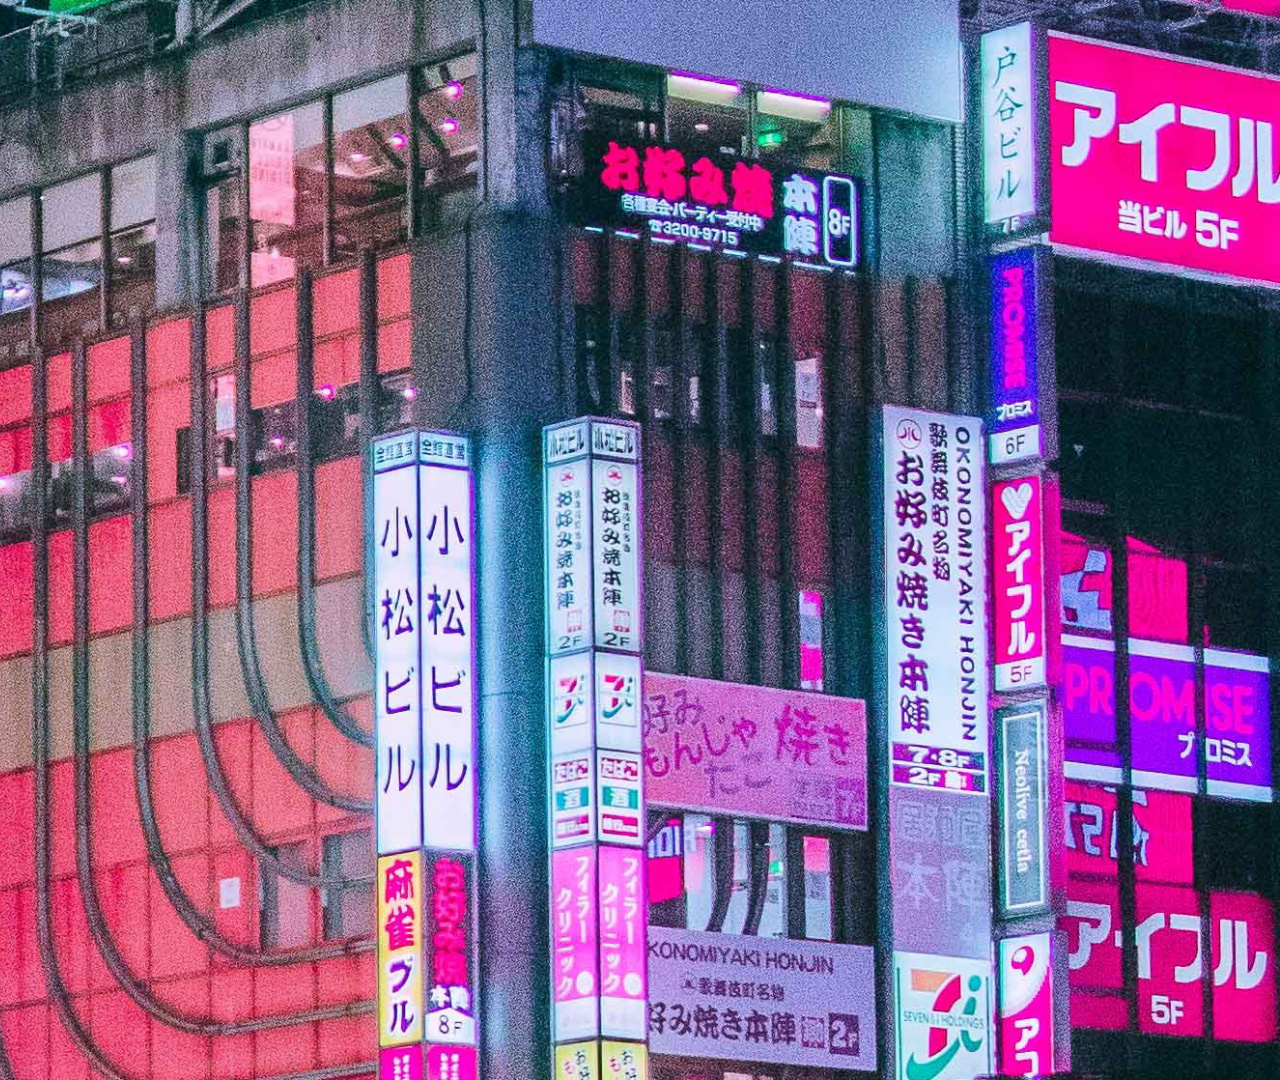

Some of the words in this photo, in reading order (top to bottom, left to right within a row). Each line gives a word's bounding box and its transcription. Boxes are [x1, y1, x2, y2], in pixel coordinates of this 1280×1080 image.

[993, 45, 1023, 201] 戸谷ビル
[1054, 79, 1280, 205] アイフル
[662, 221, 739, 246] 3200-9715
[828, 208, 851, 237] 8F
[1001, 216, 1021, 234] 7F
[1117, 199, 1188, 240] 当ビル
[1195, 209, 1240, 250] 5F
[1001, 265, 1027, 391] PROMISE
[997, 400, 1033, 421] プロミス
[1005, 432, 1026, 456] 6F
[953, 425, 975, 625] OKONOMIYAKI
[896, 449, 931, 735] お好み焼き本陣
[1003, 521, 1036, 657] アイフル
[380, 504, 416, 794] 小松ビル
[426, 504, 467, 793] 小松ビル
[559, 635, 583, 650] 2F
[602, 631, 632, 648] 2F
[1009, 664, 1033, 685] 5F
[959, 637, 977, 742] HONJIN
[1064, 663, 1255, 735] PROMISE
[773, 703, 851, 768] 焼き
[1178, 731, 1254, 768] プロミス
[907, 766, 940, 787] 2F
[1014, 748, 1032, 821] Neolive
[574, 856, 593, 945] フィラー
[623, 858, 641, 946] フィラー
[384, 858, 416, 1032] 麻雀ブル
[556, 883, 579, 997] クリニック
[604, 883, 626, 995] クリニック
[765, 950, 835, 976] HONJIN
[1066, 900, 1268, 990] アイフル
[439, 1014, 463, 1036] 8F
[941, 1013, 985, 1031] HOLDINGS
[1150, 994, 1185, 1026] 5F
